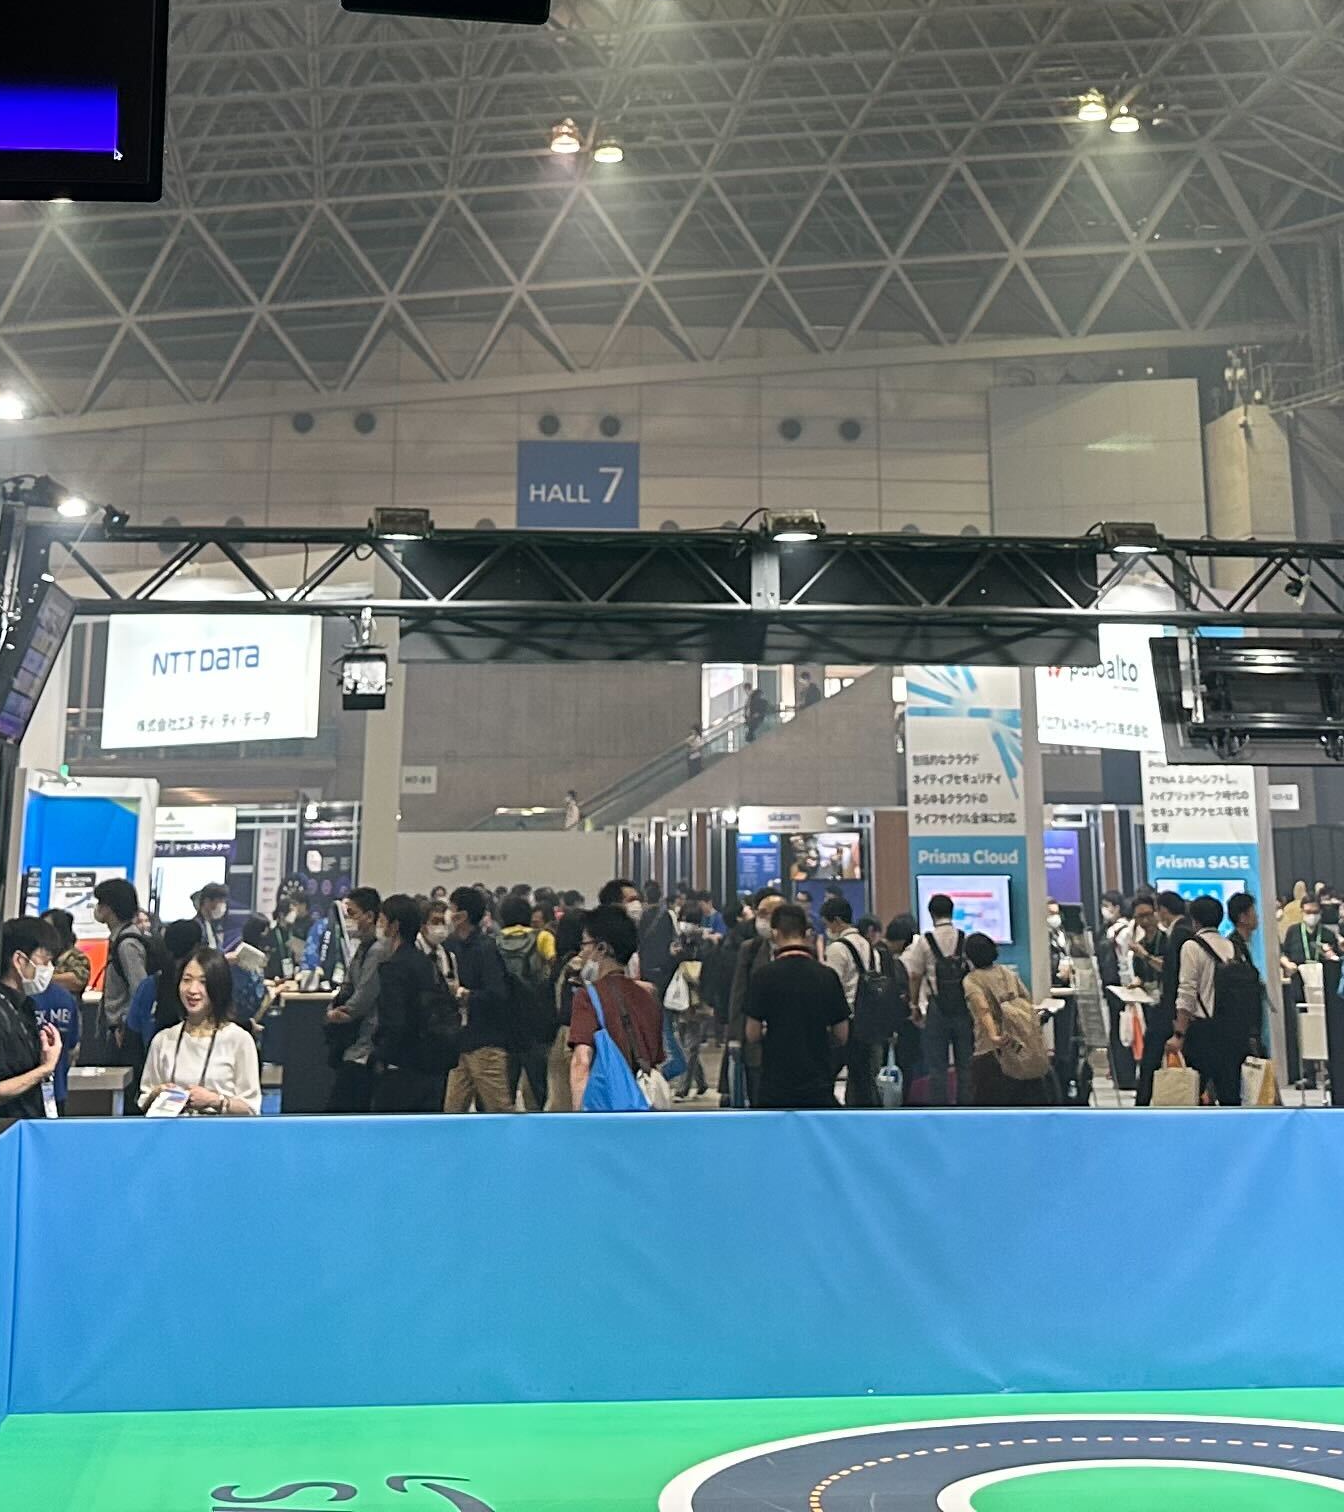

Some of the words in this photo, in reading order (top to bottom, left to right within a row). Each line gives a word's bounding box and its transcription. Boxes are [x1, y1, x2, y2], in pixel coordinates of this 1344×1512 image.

[529, 483, 591, 504] HALL
[599, 466, 625, 504] 7
[152, 651, 197, 677] NTT
[917, 848, 971, 865] Prisma
[972, 849, 1019, 865] Cloud
[1155, 853, 1206, 869] Prisma
[1207, 855, 1250, 870] SASE
